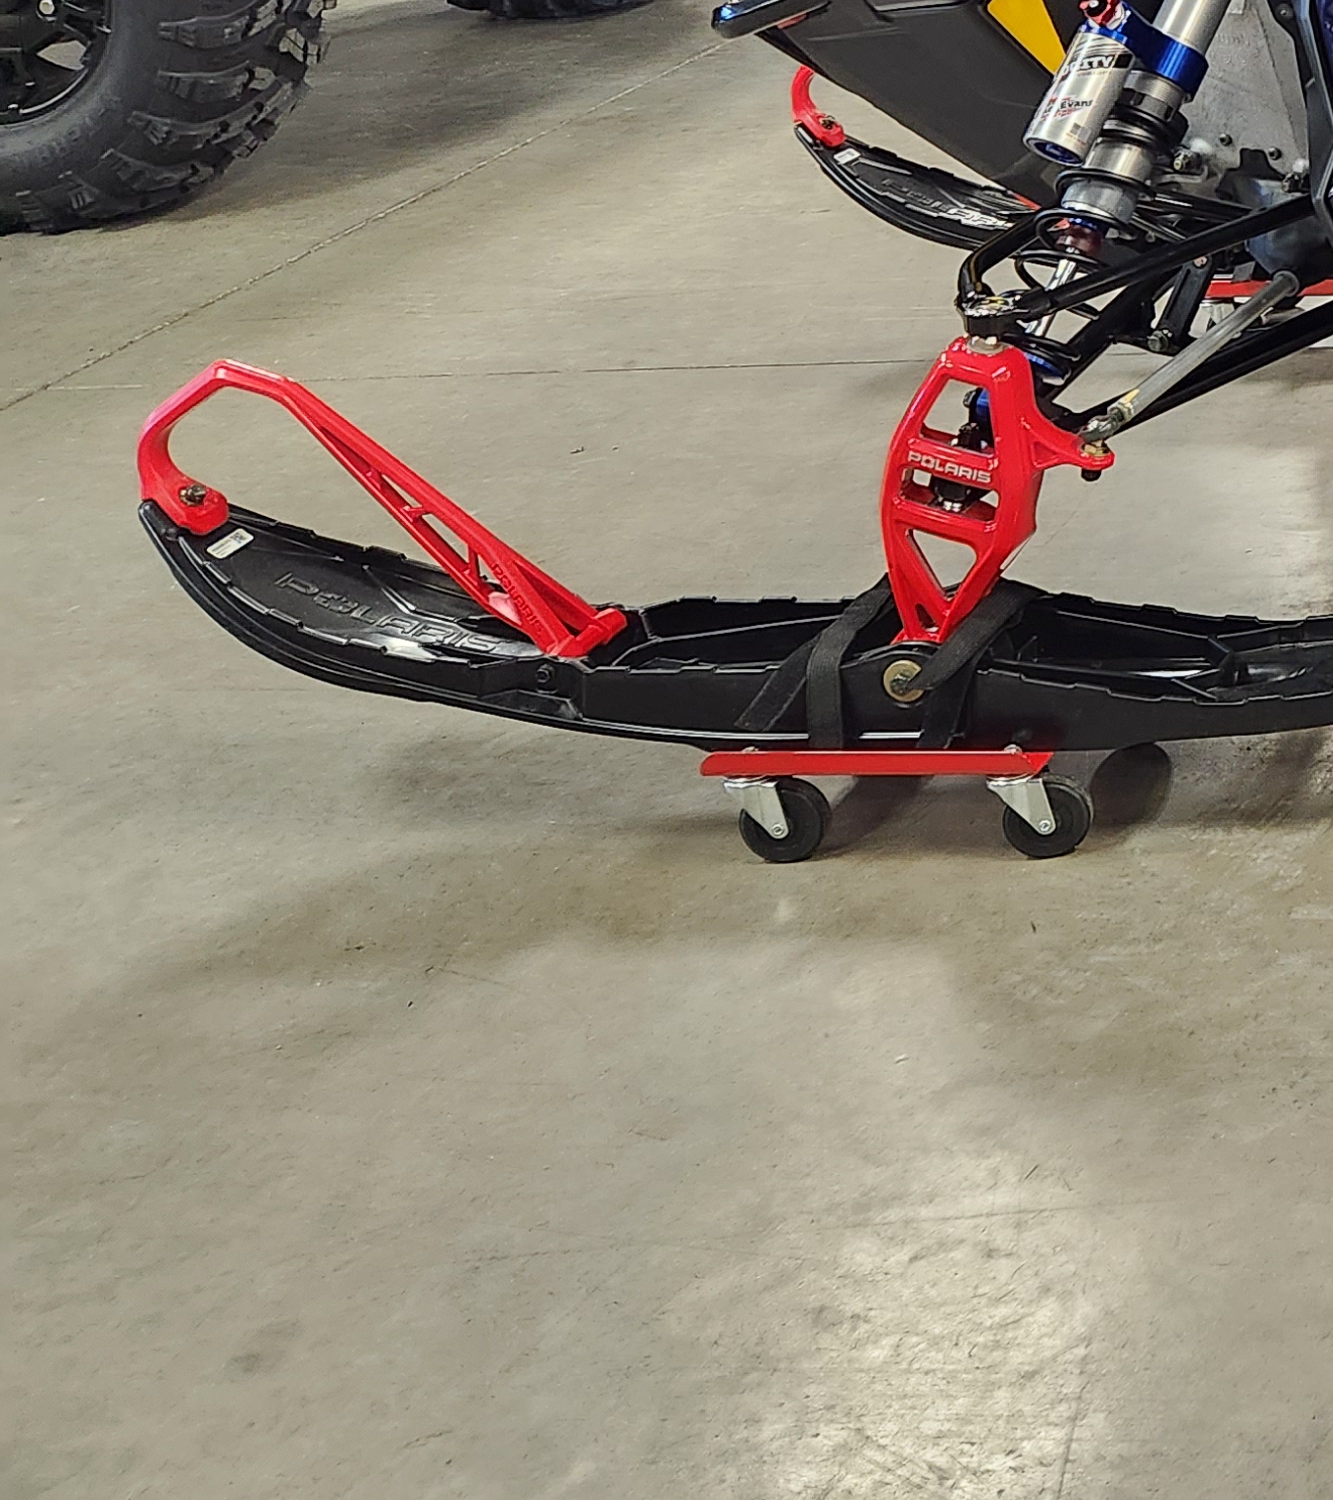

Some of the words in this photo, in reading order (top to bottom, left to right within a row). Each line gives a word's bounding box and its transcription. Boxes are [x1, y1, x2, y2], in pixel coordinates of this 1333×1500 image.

[907, 450, 993, 485] POLARIS
[273, 571, 502, 653] POLARIS
[491, 561, 545, 639] POLARIS
